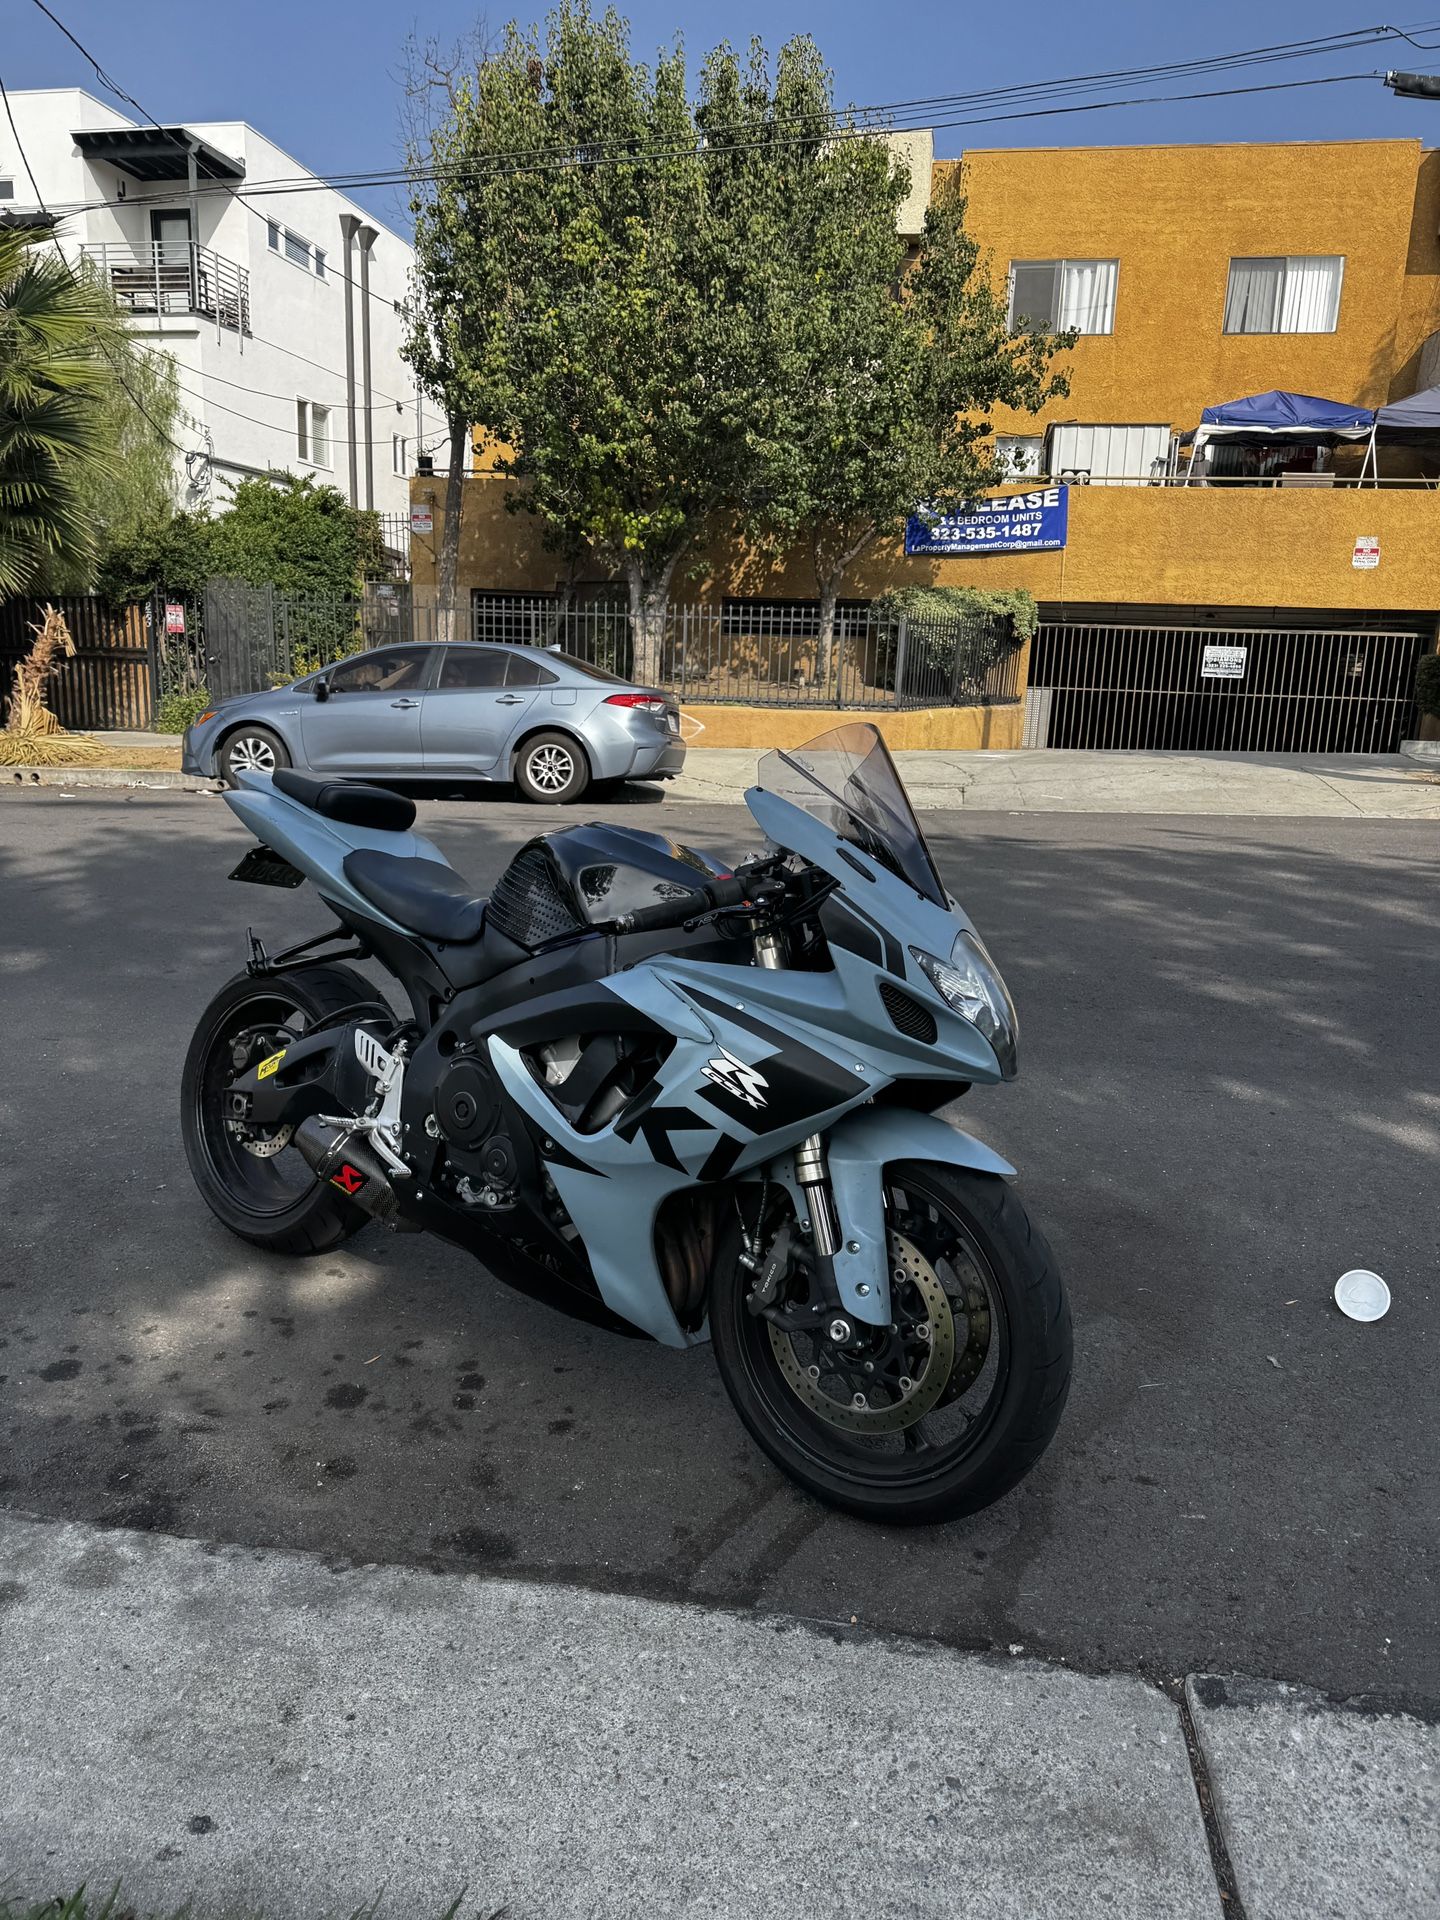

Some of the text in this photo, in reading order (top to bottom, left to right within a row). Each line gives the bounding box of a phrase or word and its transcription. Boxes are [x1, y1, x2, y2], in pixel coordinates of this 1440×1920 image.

[957, 514, 1010, 526] BEDROOM
[1012, 511, 1043, 523] UNITS
[931, 523, 1043, 541] 323-535-1487
